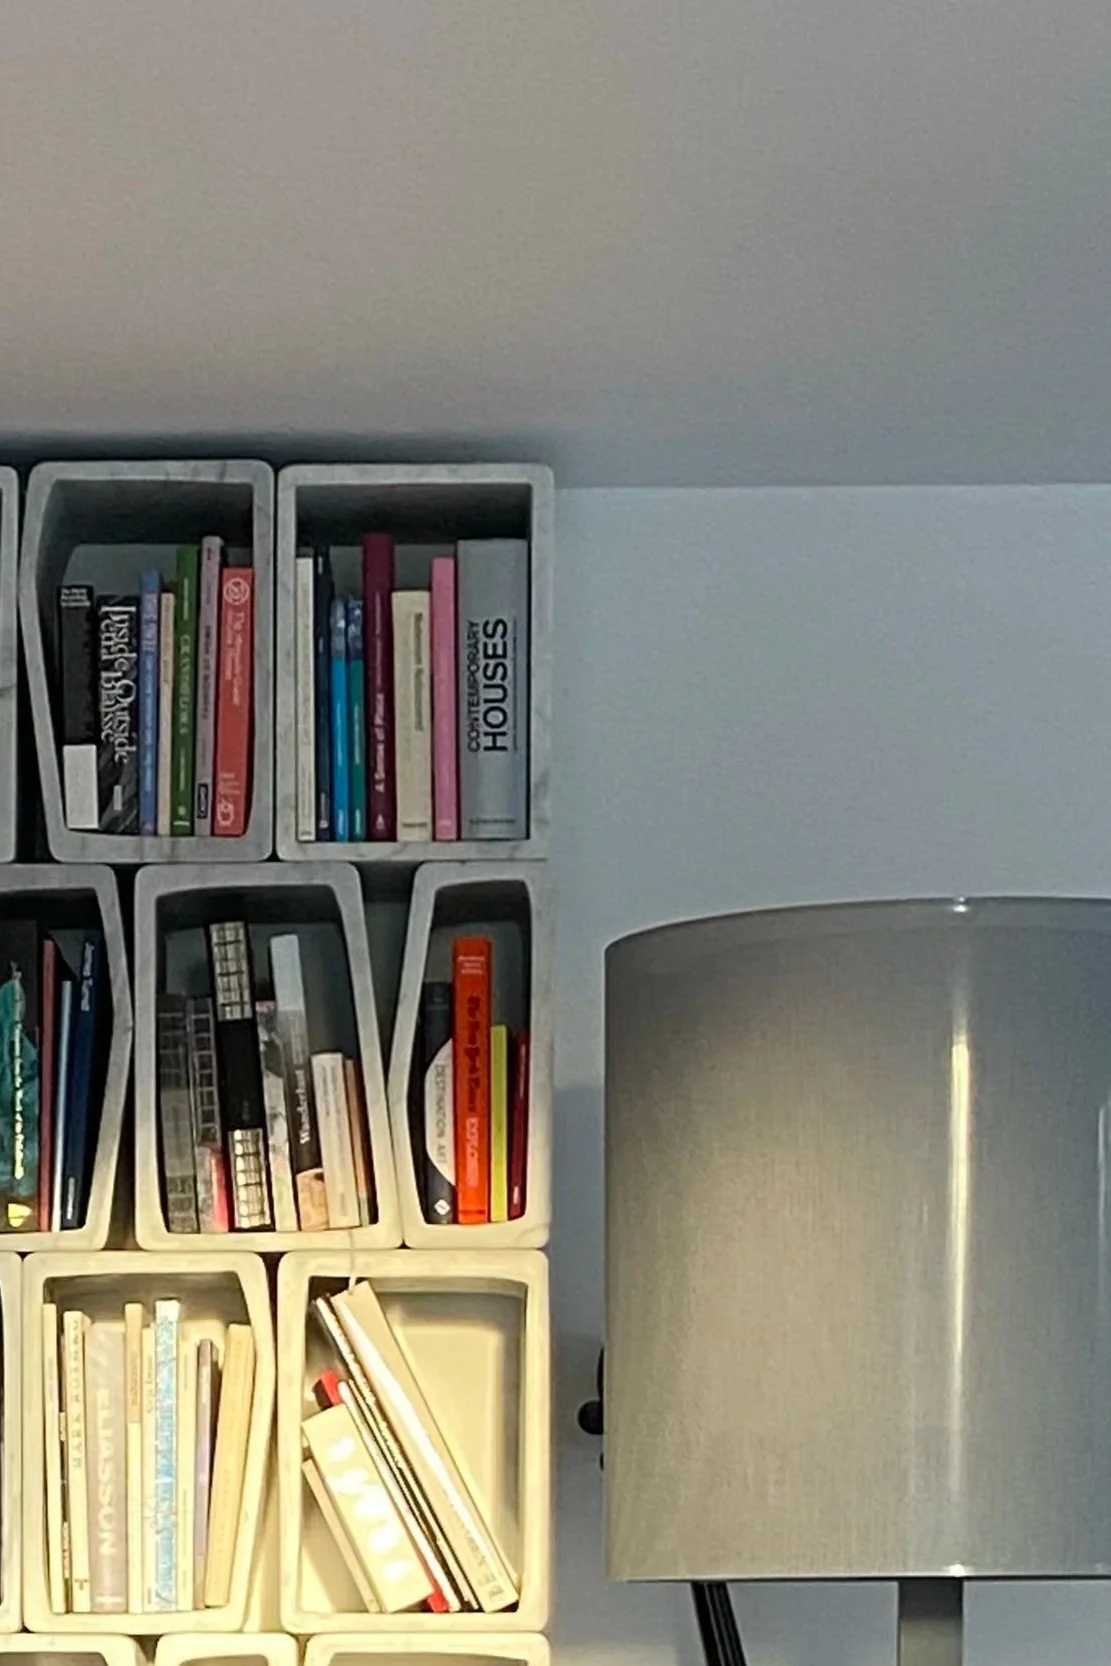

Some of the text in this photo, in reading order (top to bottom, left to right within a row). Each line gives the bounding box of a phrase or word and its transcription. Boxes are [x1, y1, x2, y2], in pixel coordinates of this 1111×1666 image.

[374, 692, 385, 727] Place
[466, 620, 481, 753] CONTEMPORARY
[482, 618, 509, 753] HOUSES
[374, 743, 386, 780] Sense
[435, 1063, 451, 1165] DESTINATION ART
[95, 1386, 119, 1557] ELIASSON
